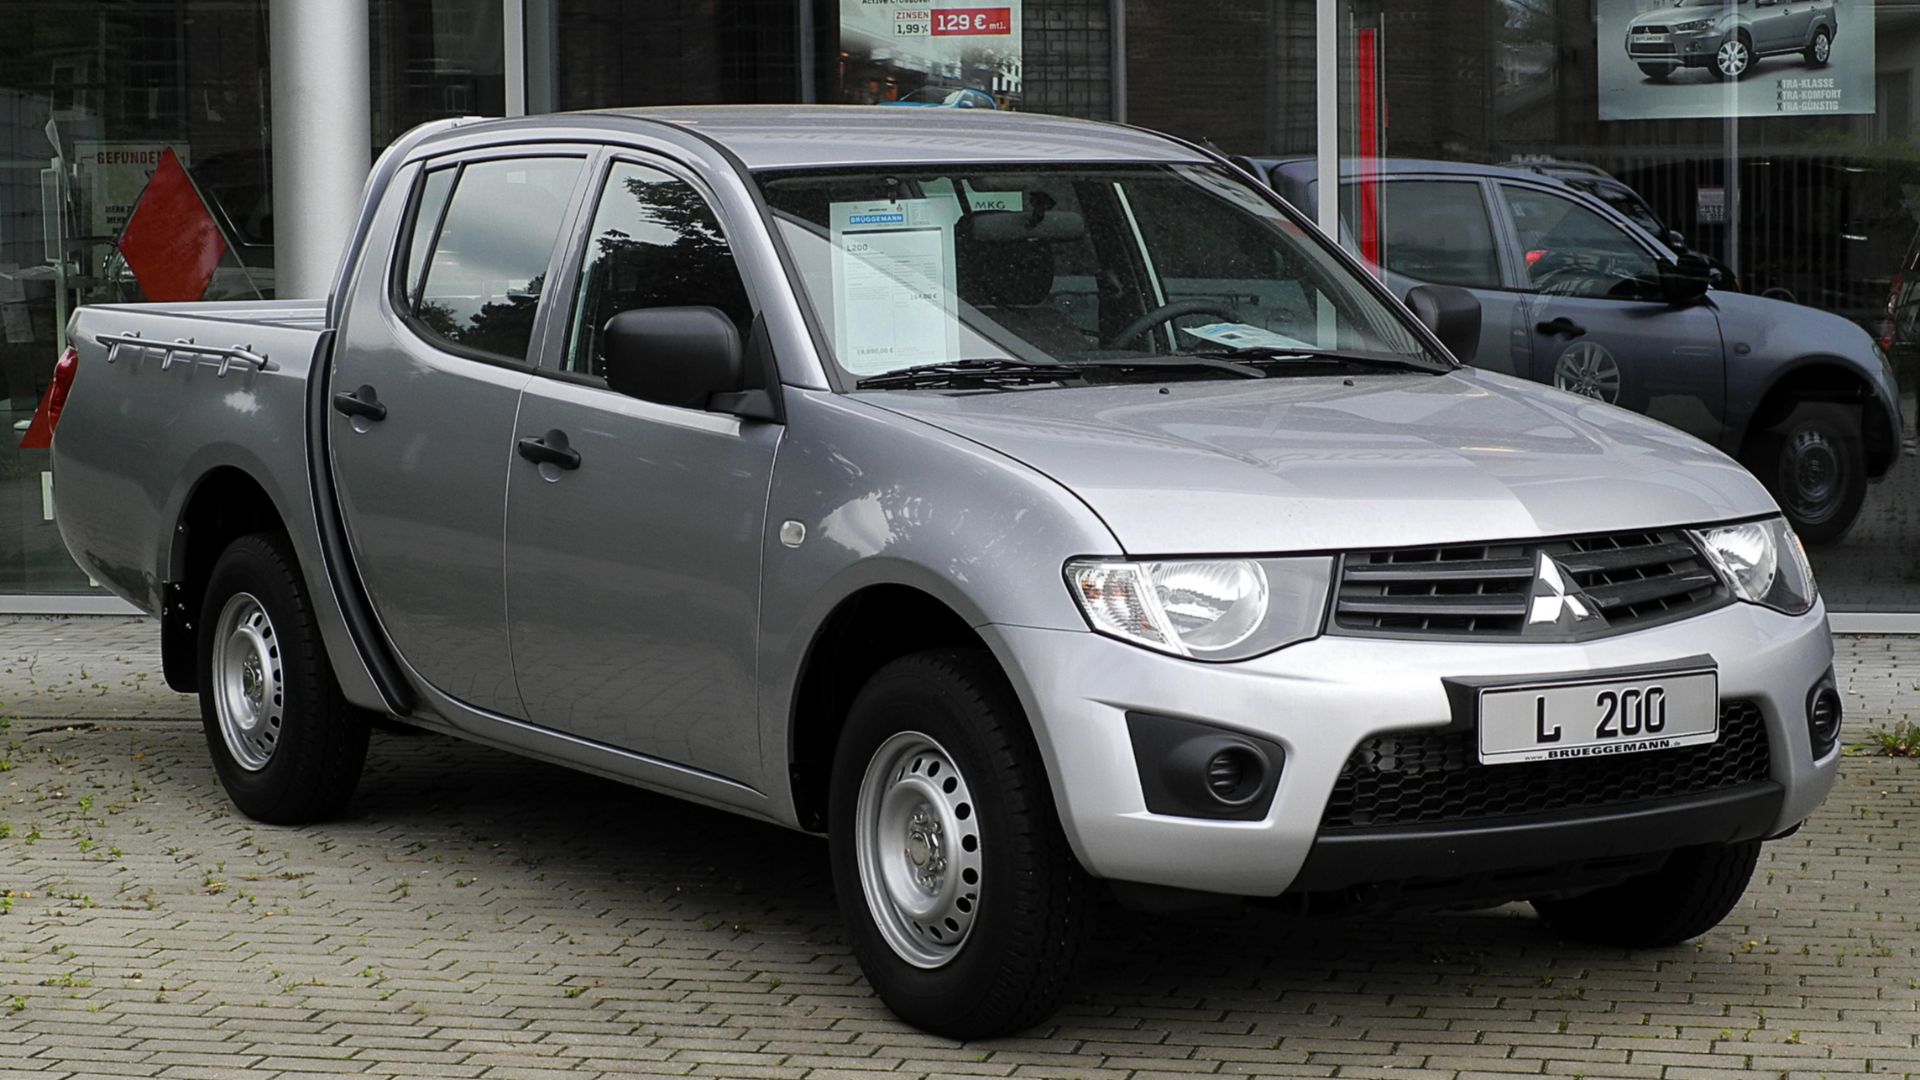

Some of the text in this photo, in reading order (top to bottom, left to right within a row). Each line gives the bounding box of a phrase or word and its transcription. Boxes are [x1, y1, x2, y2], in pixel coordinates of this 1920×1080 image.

[937, 14, 1007, 31] 129 € mtl.
[897, 24, 920, 34] 1,99
[1777, 78, 1835, 89] XTRA-KLASSE
[1777, 89, 1842, 100] XTRA-KOMFORT
[975, 201, 1006, 209] MKG
[847, 243, 868, 252] L200
[1536, 687, 1666, 744] L 200
